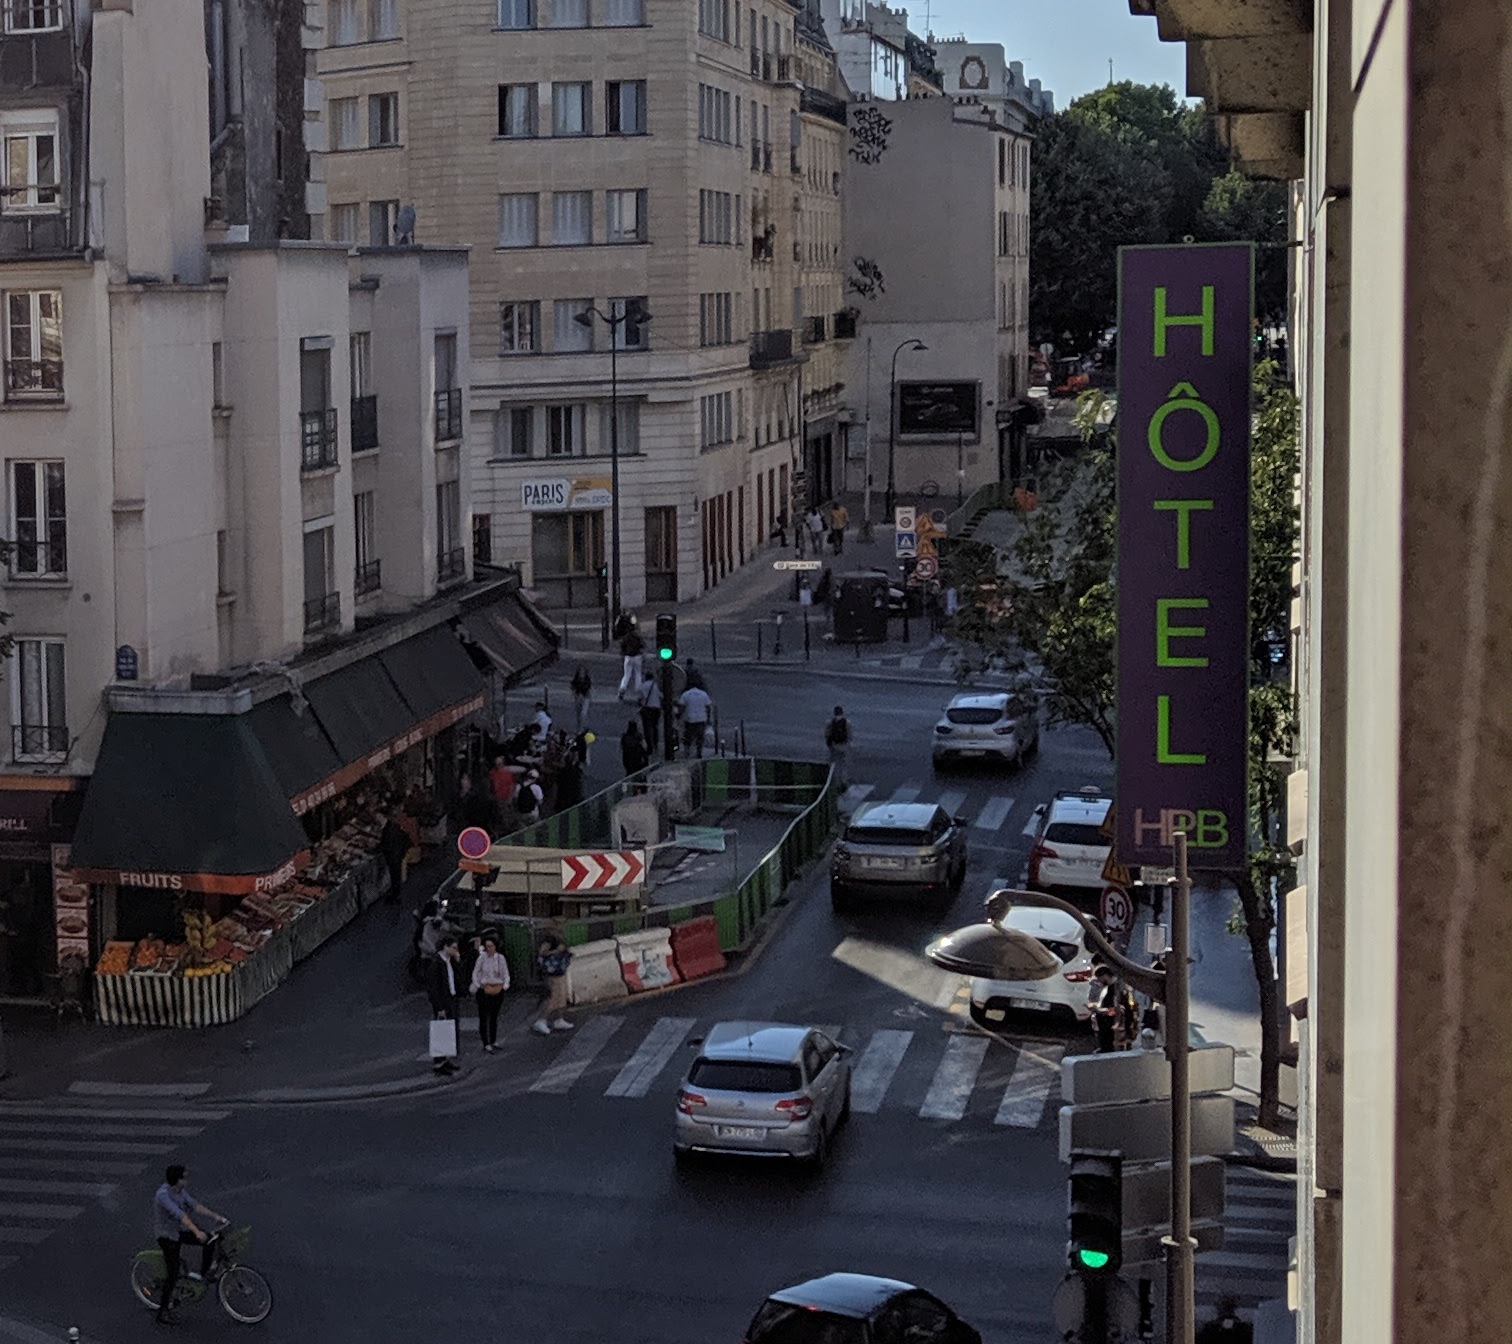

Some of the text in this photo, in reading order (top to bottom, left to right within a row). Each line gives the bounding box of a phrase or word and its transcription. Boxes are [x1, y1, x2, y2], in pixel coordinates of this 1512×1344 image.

[524, 483, 564, 505] PARIS
[1147, 285, 1223, 765] HÔTEL
[119, 872, 183, 890] FRUITS
[1108, 897, 1125, 920] 30
